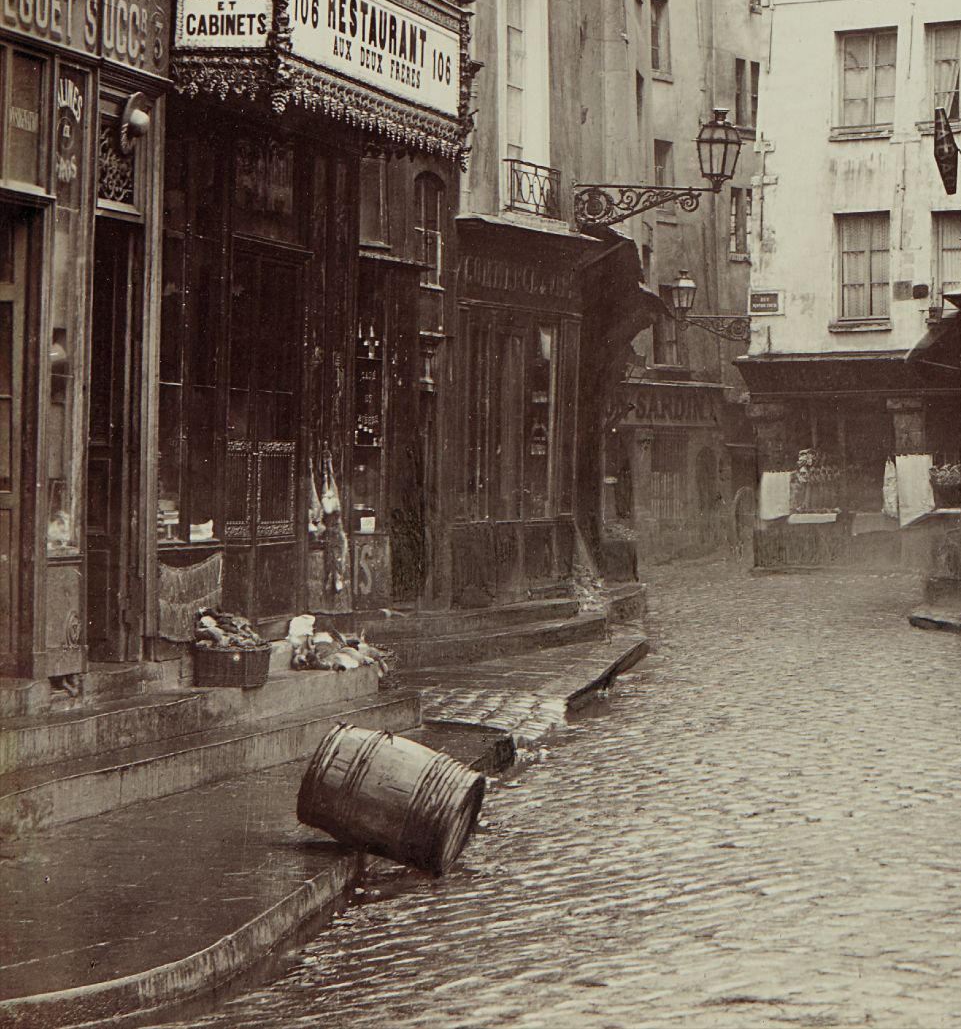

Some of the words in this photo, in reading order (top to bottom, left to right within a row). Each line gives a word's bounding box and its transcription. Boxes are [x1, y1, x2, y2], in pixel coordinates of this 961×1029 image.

[217, 1, 237, 12] ET
[186, 13, 267, 36] CABINETS
[333, 37, 352, 61] AUX
[360, 48, 383, 75] DEUX
[432, 48, 452, 86] 106
